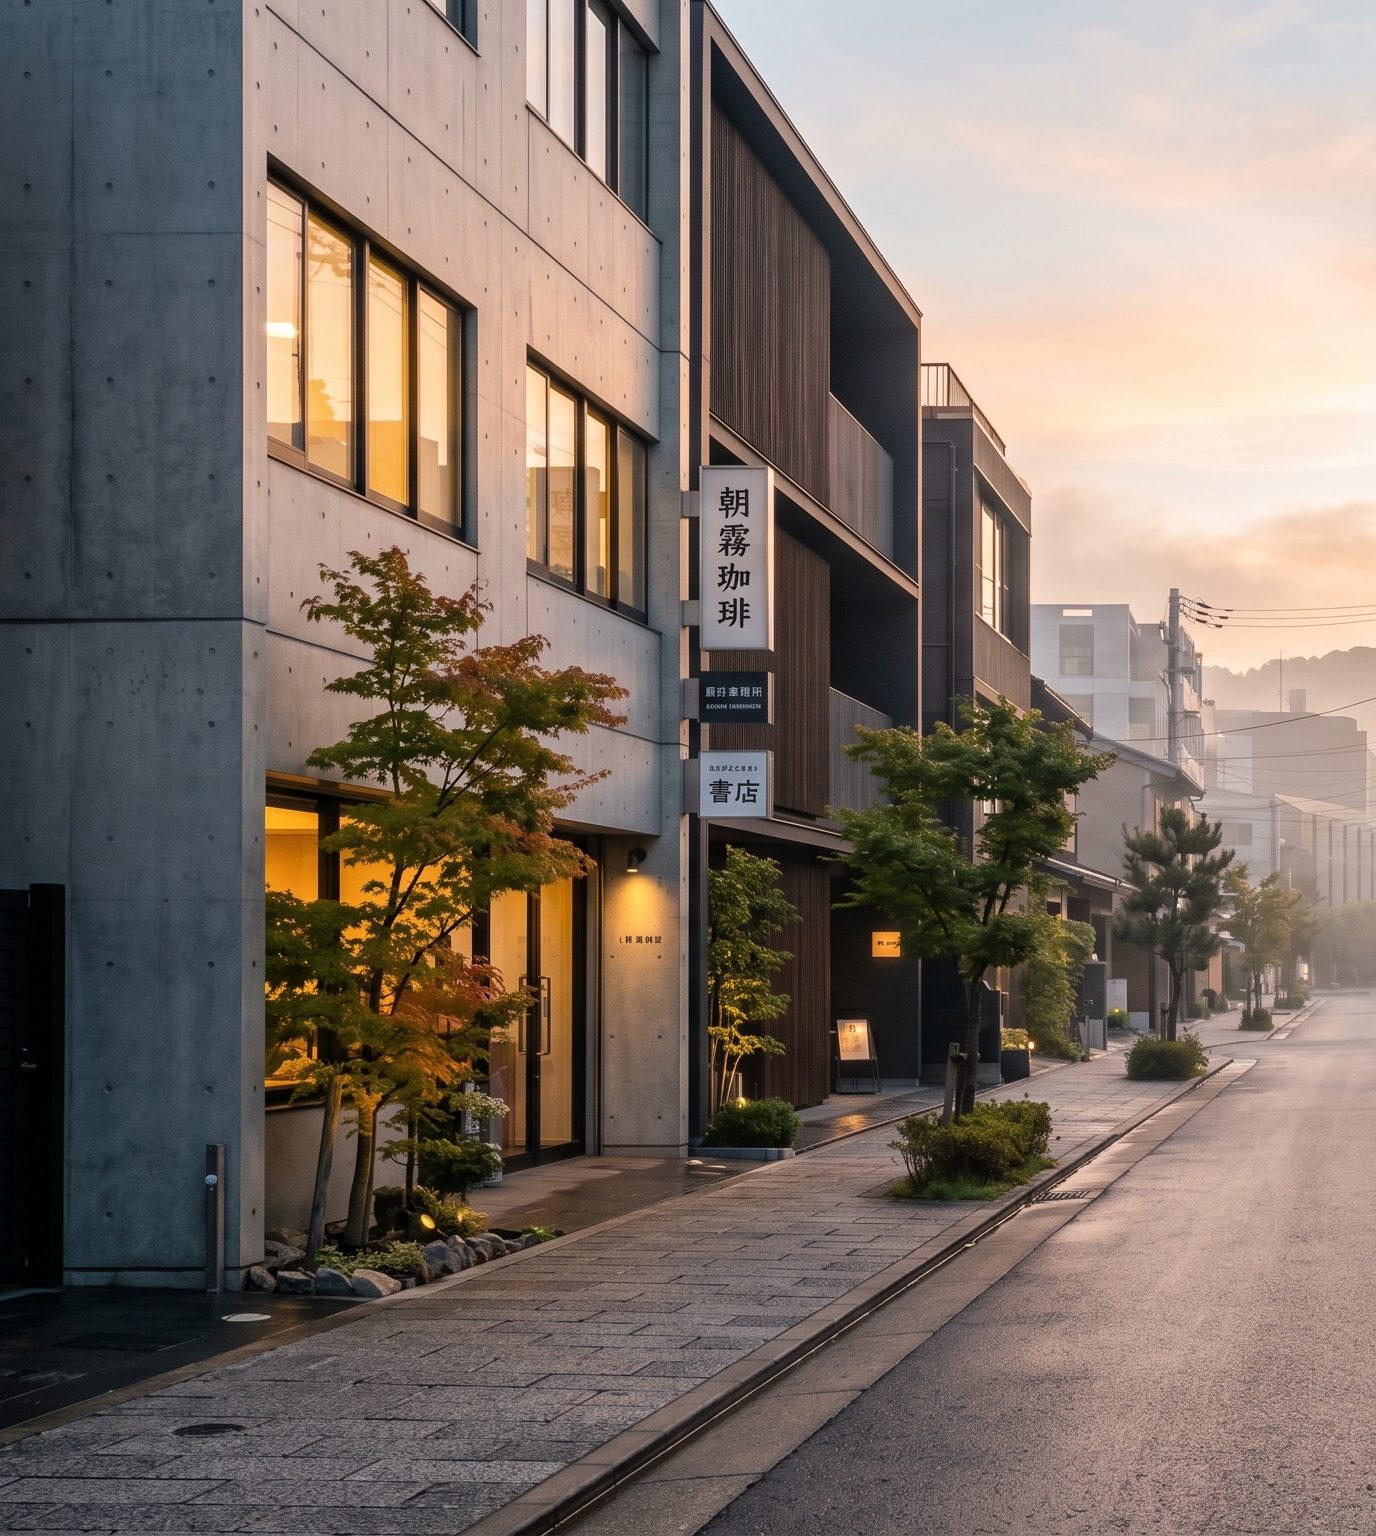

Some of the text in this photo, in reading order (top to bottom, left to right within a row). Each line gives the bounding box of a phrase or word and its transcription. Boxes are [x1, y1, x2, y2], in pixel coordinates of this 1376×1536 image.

[718, 486, 751, 629] 朝霧珈琲
[709, 778, 760, 804] 書店
